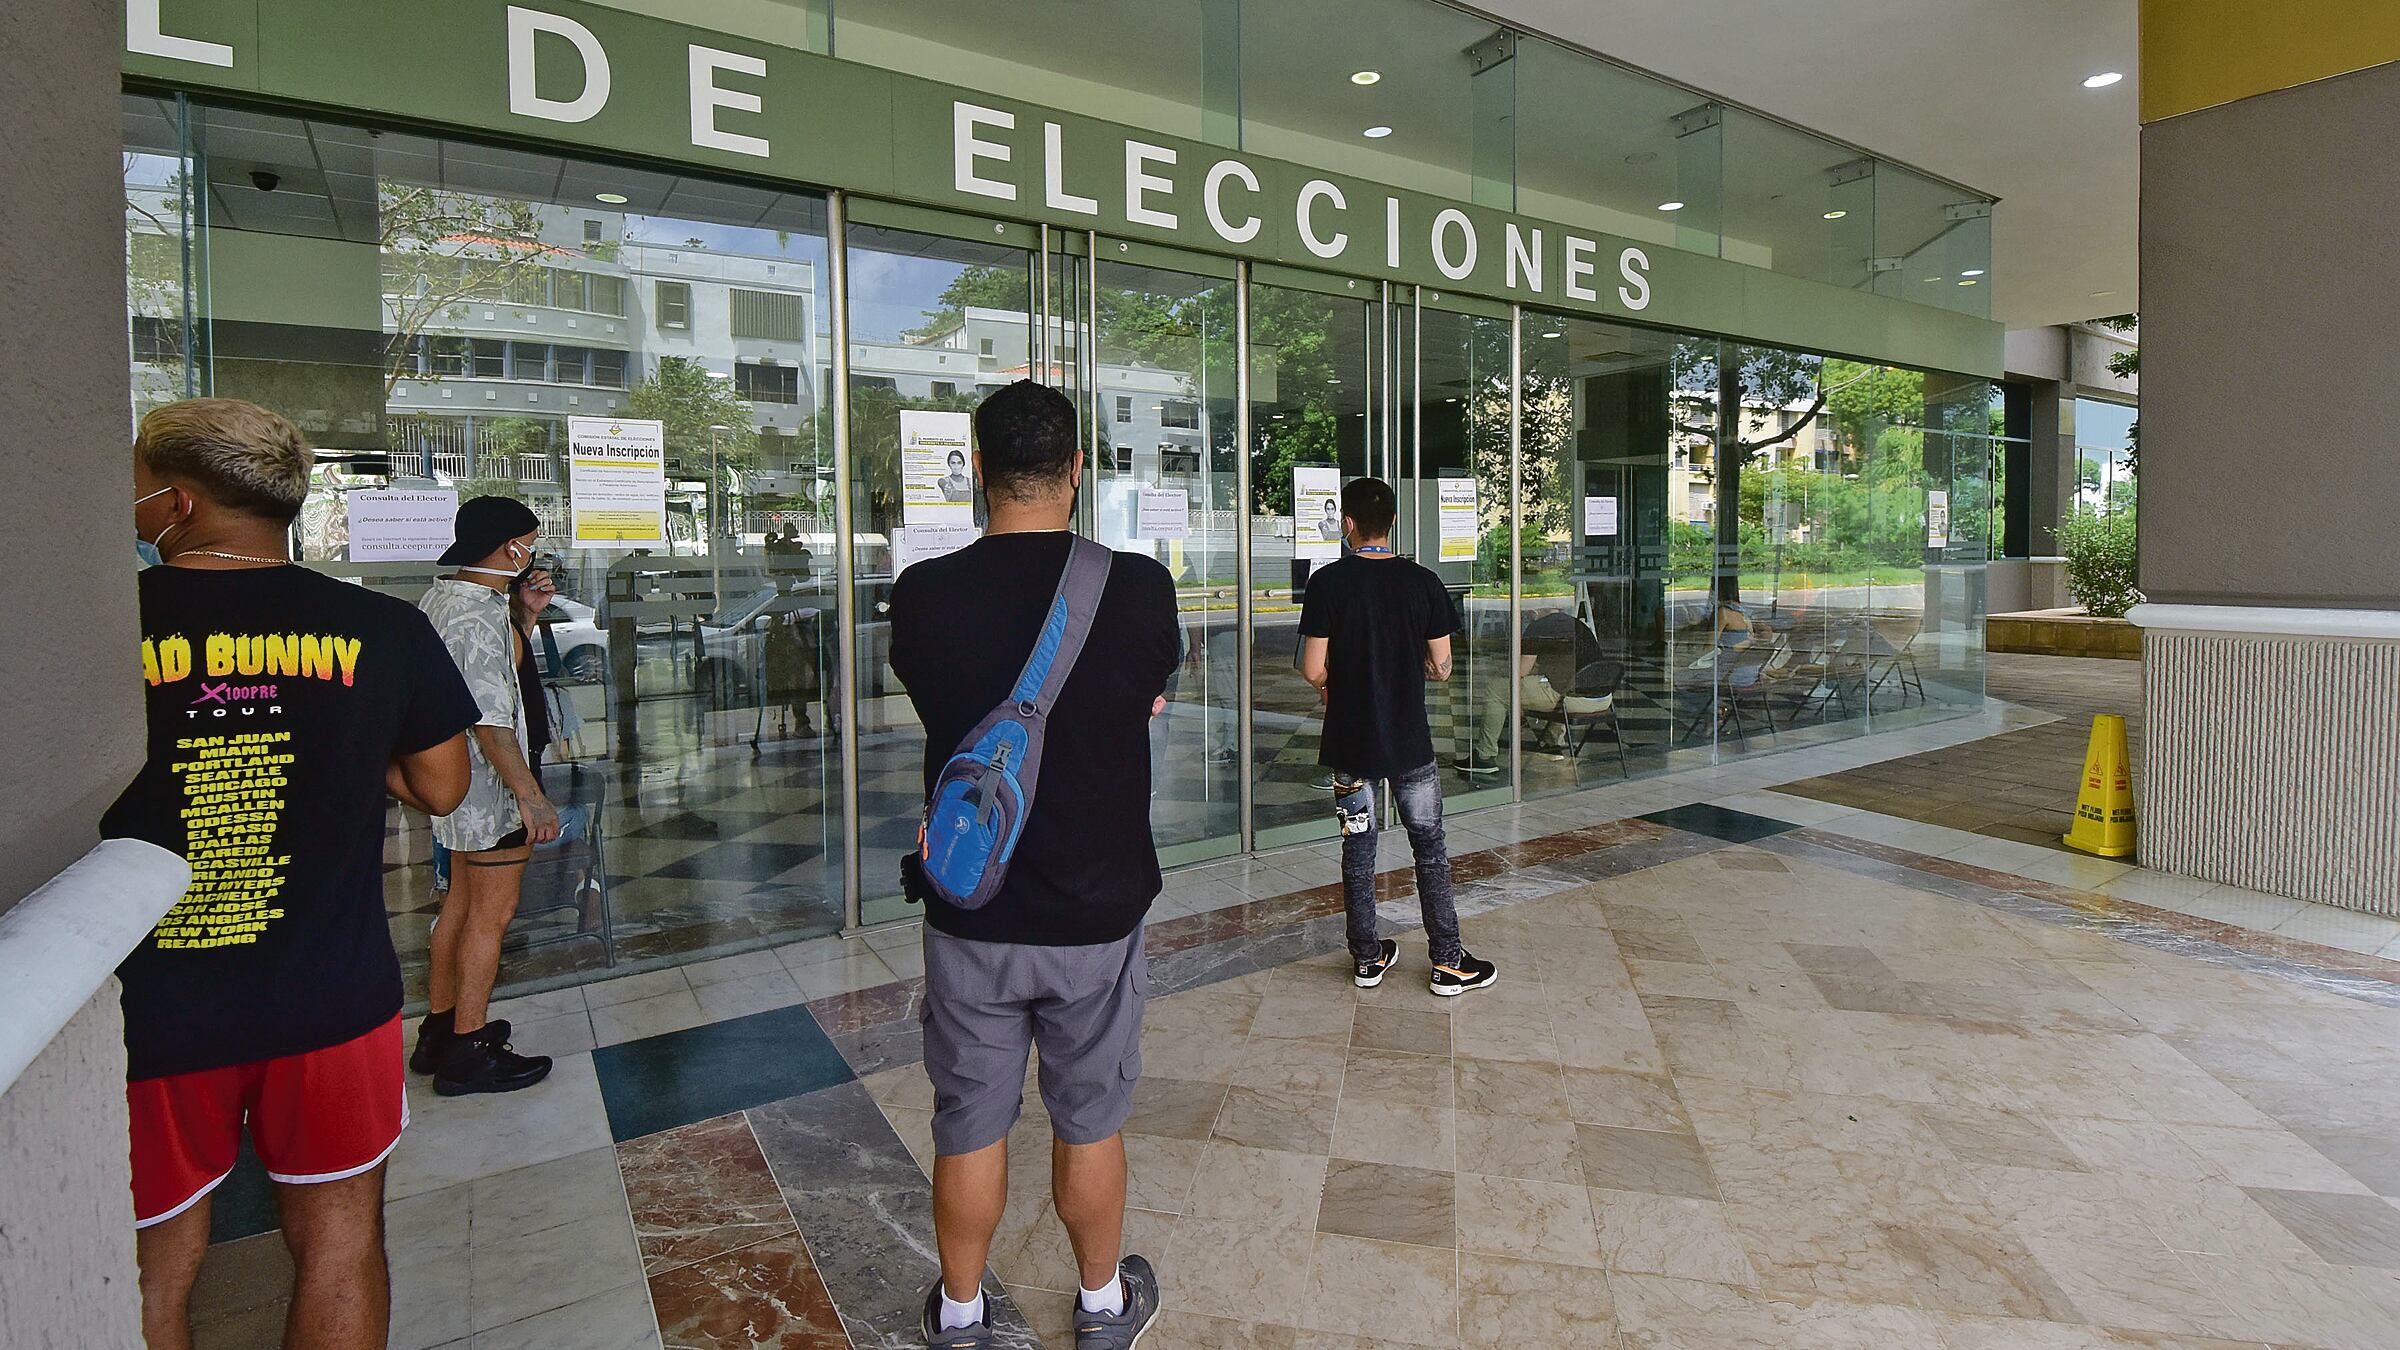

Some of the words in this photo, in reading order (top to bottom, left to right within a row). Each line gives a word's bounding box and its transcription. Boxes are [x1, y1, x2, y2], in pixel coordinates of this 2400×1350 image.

[507, 5, 771, 158] DE
[953, 100, 1651, 311] ELECCIONES
[573, 442, 604, 457] Nueva
[607, 444, 660, 461] Inscripción
[360, 494, 399, 502] Consulta
[401, 494, 414, 502] del
[416, 494, 448, 502] Elector
[142, 630, 192, 686] AD
[206, 630, 362, 687] BUNNY
[190, 682, 278, 704] X100PRE
[186, 705, 282, 718] TOUR
[176, 736, 225, 749] SAN
[228, 731, 291, 746] JUAN
[199, 744, 269, 759] MIAMI
[171, 753, 295, 773] PORTLAND
[184, 766, 282, 784] SEATTLE
[183, 777, 288, 795] CHICAGO
[190, 788, 276, 805] AUSTIN
[180, 799, 285, 819] MCALLEN
[186, 811, 279, 829] ODESSA
[187, 830, 214, 841] EL
[217, 823, 277, 838] PASO
[188, 834, 273, 851] DALLAS
[186, 845, 270, 861] LAREDO
[188, 855, 292, 870] CASVILLE
[191, 867, 275, 881] RLANDO
[187, 882, 218, 893] RT
[217, 876, 286, 891] MYERS
[178, 888, 279, 904] OACHELLA
[168, 904, 207, 916] SAN
[208, 899, 268, 913] JOSE
[157, 917, 185, 927] OS
[186, 908, 285, 925] ANGELES
[154, 926, 202, 938] NEW
[206, 921, 268, 937] YORK
[156, 933, 258, 949] READING
